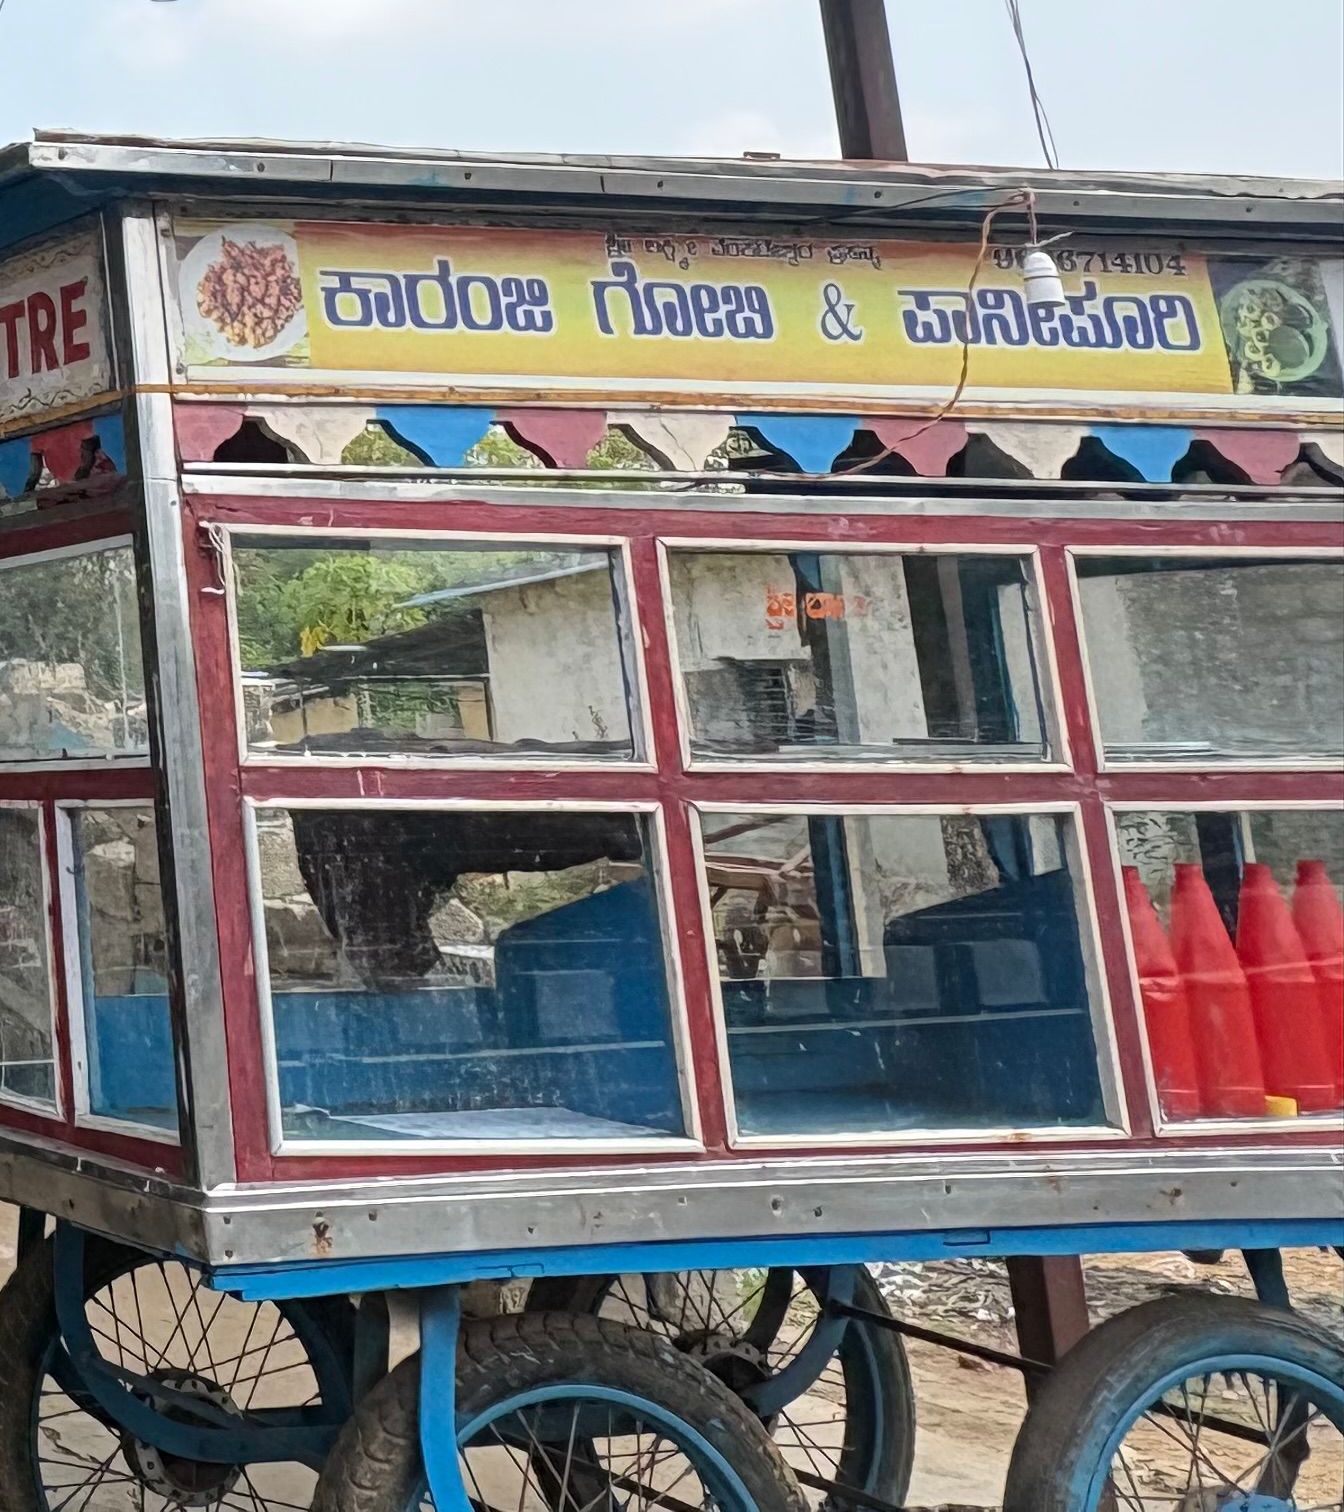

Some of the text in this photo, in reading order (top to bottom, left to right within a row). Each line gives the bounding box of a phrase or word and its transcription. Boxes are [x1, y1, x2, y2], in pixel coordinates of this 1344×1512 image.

[318, 259, 554, 332] ಕಾರಂಜಿ
[590, 261, 775, 340] ಗೋಬಿ
[819, 282, 863, 341] &
